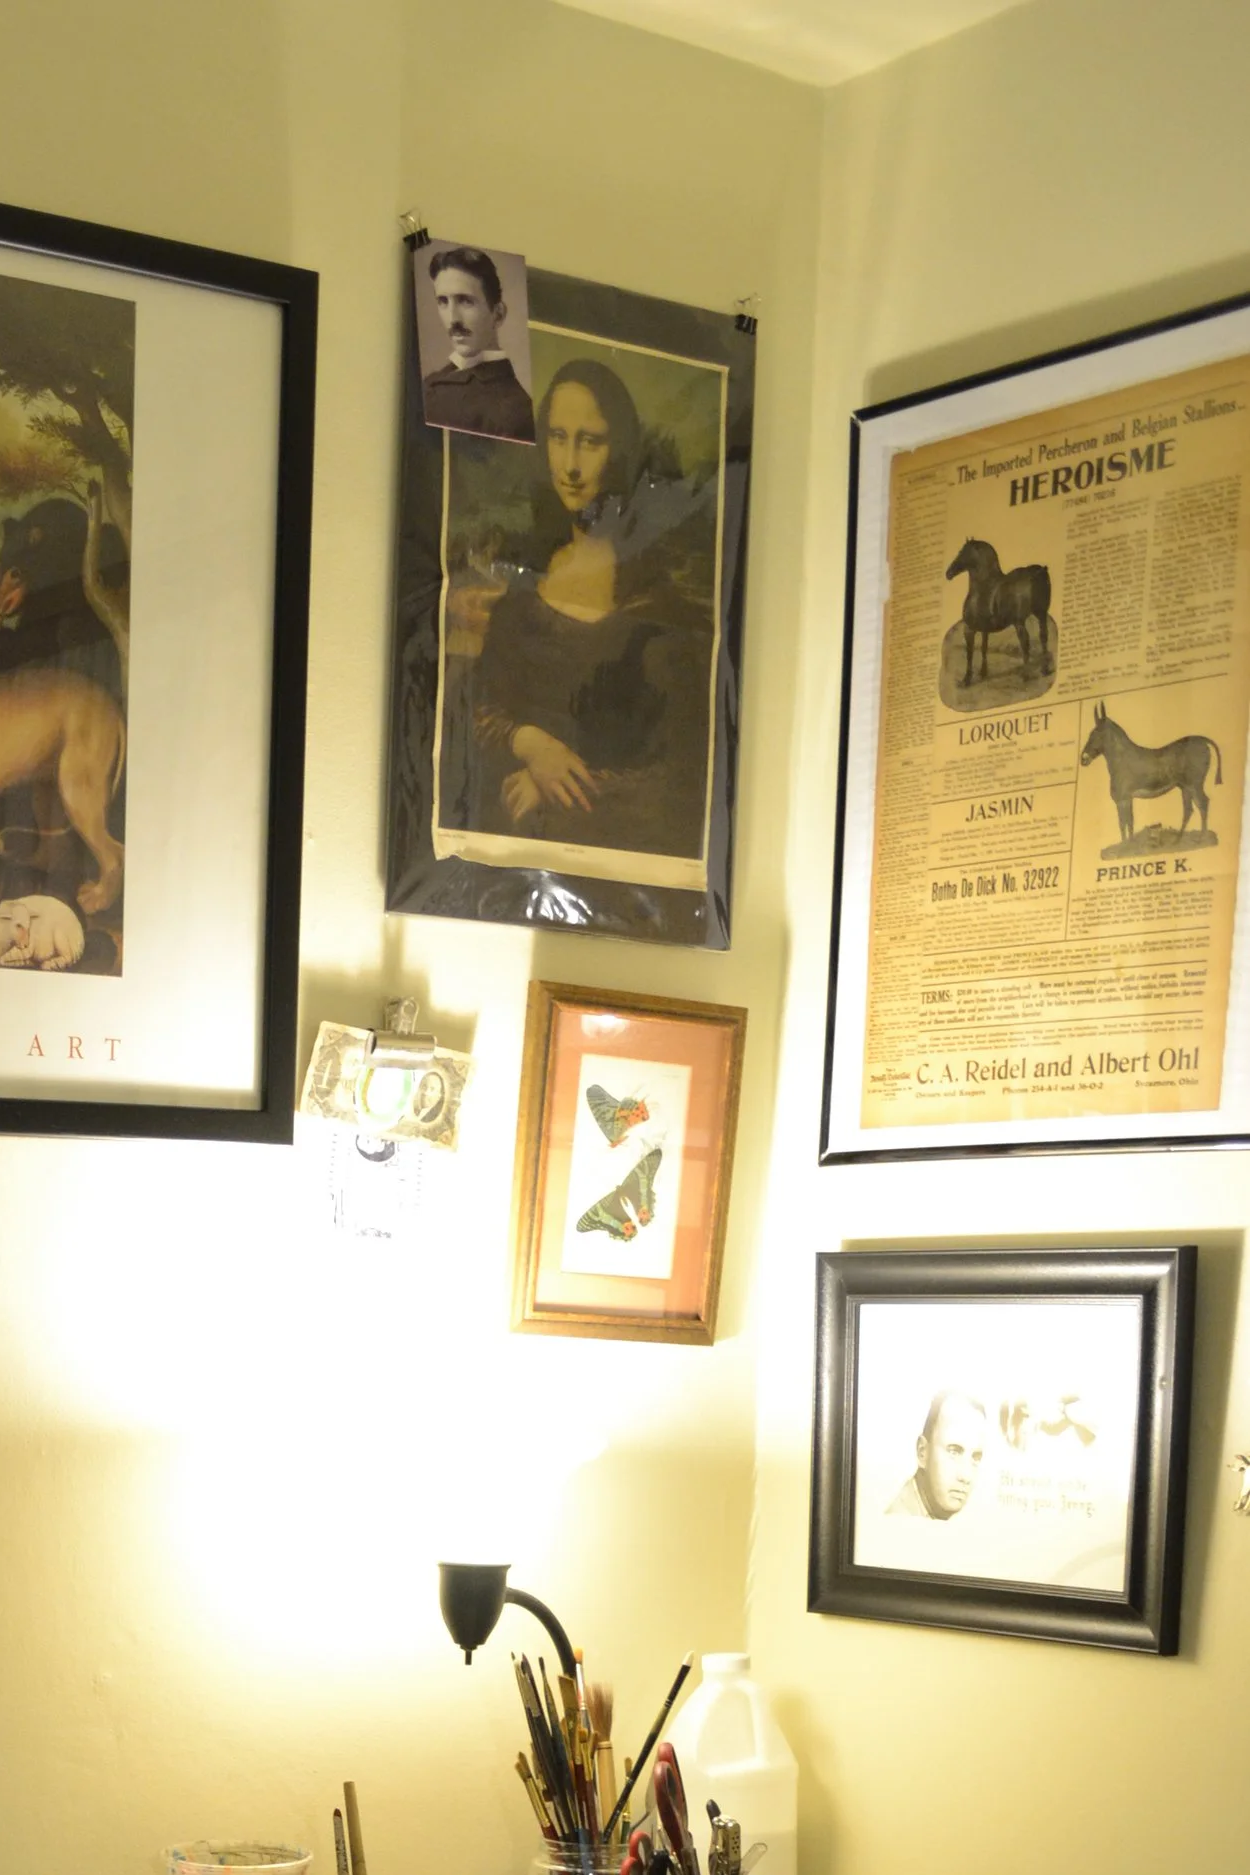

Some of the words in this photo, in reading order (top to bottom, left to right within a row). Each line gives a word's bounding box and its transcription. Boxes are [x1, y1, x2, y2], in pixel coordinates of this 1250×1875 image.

[957, 464, 978, 485] The
[982, 447, 1033, 478] Imported
[1038, 437, 1098, 463] Percheron
[1103, 422, 1126, 446] and
[1132, 413, 1178, 438] Belgian
[1182, 399, 1237, 425] Stallions
[1009, 438, 1177, 508] HEROISME
[959, 712, 1053, 746] LORIQUET
[965, 794, 1035, 823] JASMIN
[961, 878, 974, 899] De
[976, 874, 997, 897] Dick
[1002, 872, 1018, 894] No.
[1023, 866, 1060, 892] 32922
[1095, 860, 1167, 883] PRINCE
[1174, 857, 1193, 874] K.
[27, 1033, 123, 1062] ART
[916, 1062, 934, 1086] C.
[940, 1062, 959, 1085] A.
[966, 1057, 1027, 1085] Reidel
[1034, 1054, 1073, 1080] and
[1080, 1051, 1151, 1077] Albert
[1158, 1045, 1200, 1072] Ohl
